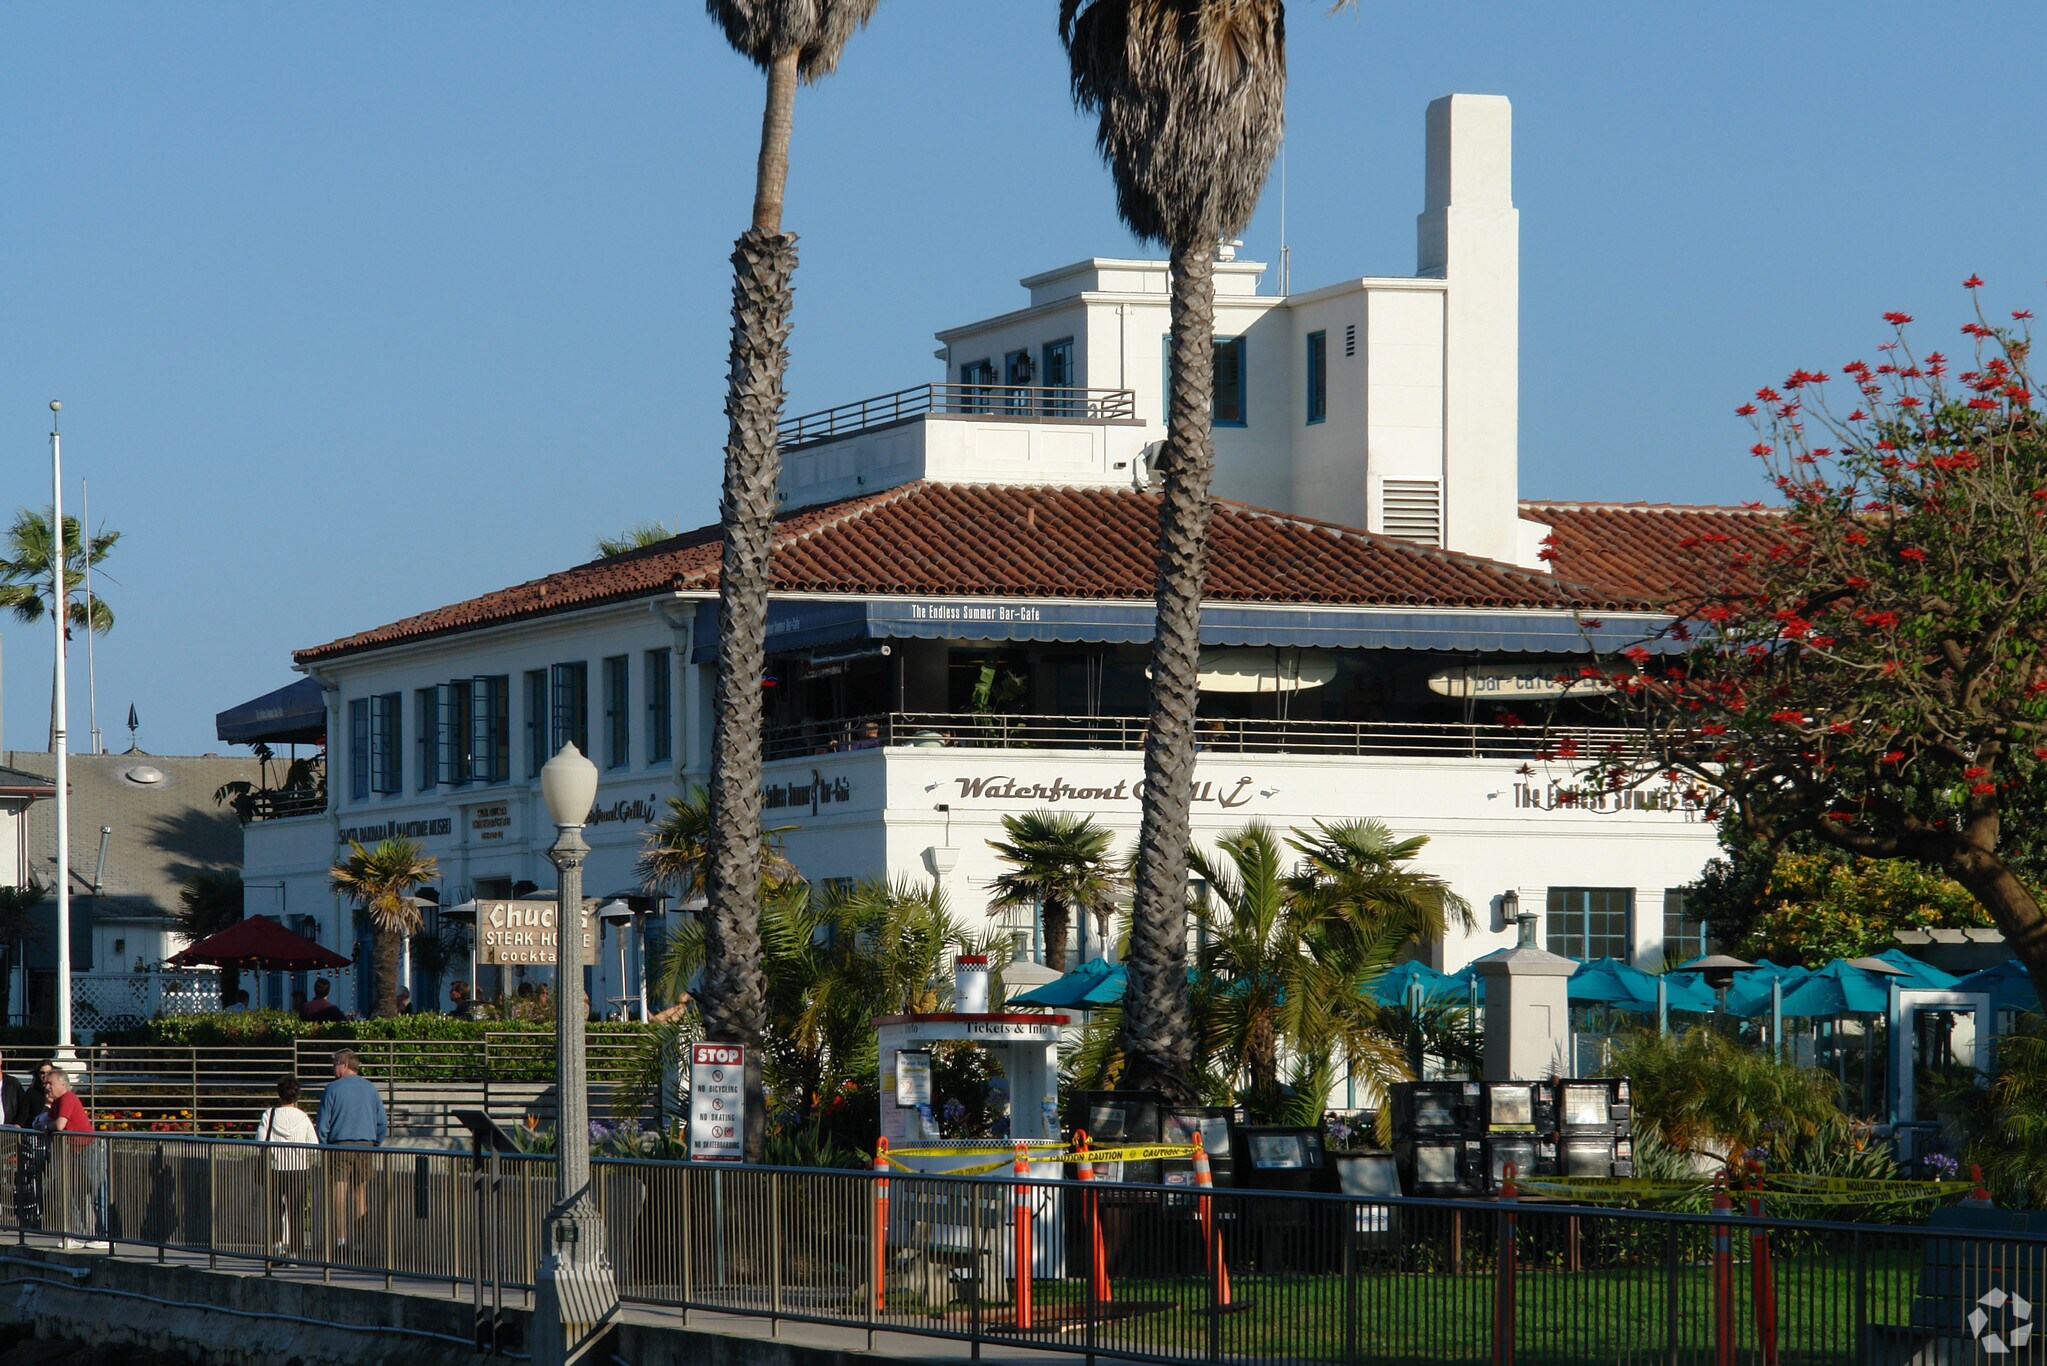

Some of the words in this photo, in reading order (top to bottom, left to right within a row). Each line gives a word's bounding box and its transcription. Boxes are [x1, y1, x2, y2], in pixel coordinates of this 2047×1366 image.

[912, 605, 926, 619] The
[929, 605, 960, 620] Endless
[963, 606, 996, 621] Summer
[1000, 607, 1040, 621] Bar-Cafe
[954, 776, 1128, 801] Waterfront
[1513, 783, 1540, 808] The
[486, 931, 534, 946] STEAK
[964, 1021, 1011, 1034] Tickets
[1013, 1023, 1025, 1034] &
[1028, 1022, 1048, 1034] Info
[697, 1048, 739, 1063] STOP
[698, 1085, 706, 1093] NO
[709, 1085, 738, 1094] BICYCLING
[700, 1113, 708, 1121] NO
[711, 1113, 735, 1122] SKATING
[694, 1140, 702, 1149] NO
[1088, 1151, 1123, 1161] CAUTION
[1143, 1149, 1180, 1158] CAUTION
[1846, 1192, 1892, 1203] CAUTION
[1894, 1185, 1941, 1200] CAUTION
